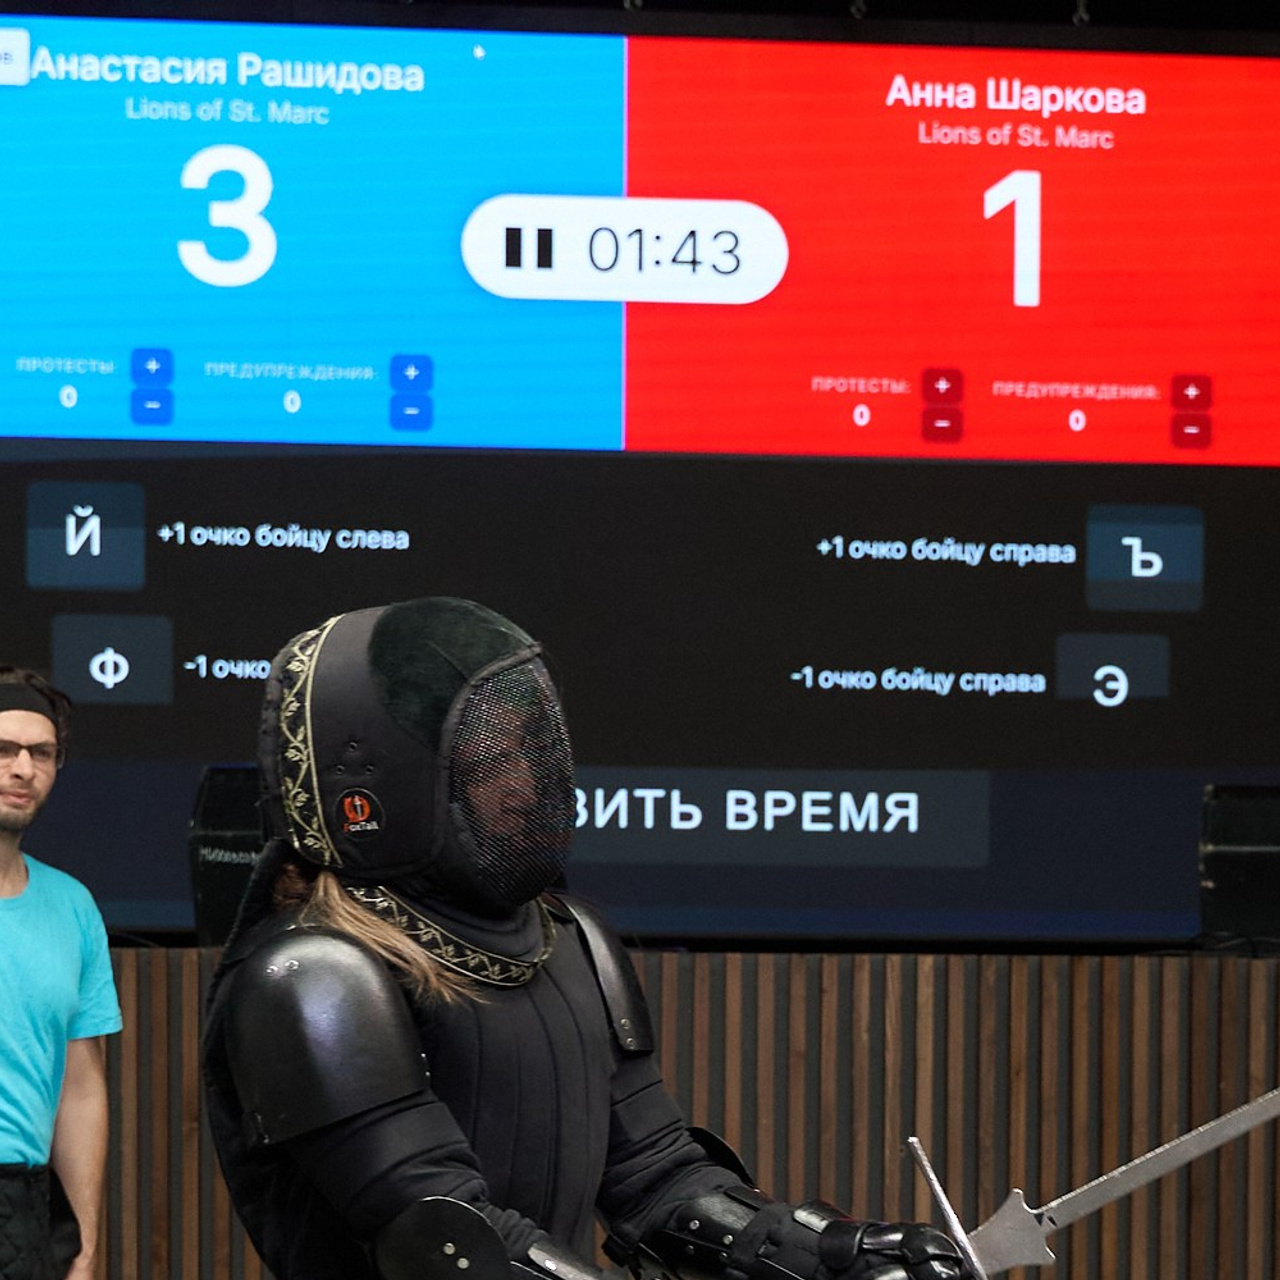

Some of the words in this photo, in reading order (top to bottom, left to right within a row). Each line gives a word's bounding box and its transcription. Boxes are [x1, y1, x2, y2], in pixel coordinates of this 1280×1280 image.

[31, 46, 227, 85] Анастасия
[238, 52, 425, 95] Рашидова
[126, 98, 192, 121] Lions
[197, 99, 223, 121] of
[230, 100, 261, 123] St.
[268, 102, 329, 125] Marc
[885, 74, 976, 109] Анна
[986, 78, 1146, 119] Шаркова
[918, 122, 982, 145] Lions
[986, 124, 1013, 146] of
[1017, 124, 1049, 147] St.
[1055, 126, 1114, 149] Marc
[178, 144, 277, 287] 3
[588, 226, 741, 275] 01:43
[984, 171, 1041, 307] 1
[59, 384, 78, 409] 0
[283, 389, 302, 414] 0
[852, 403, 871, 427] 0
[1068, 409, 1087, 432] 0
[65, 505, 101, 557] Й
[158, 521, 186, 545] +1
[190, 526, 251, 547] очко
[254, 523, 332, 554] бойцу
[335, 529, 410, 550] слева
[816, 535, 844, 558] +1
[848, 540, 907, 560] очко
[911, 537, 986, 566] бойцу
[989, 543, 1076, 566] справа
[1121, 536, 1164, 578] Ъ
[89, 647, 130, 689] Ф
[183, 654, 207, 678] -1
[212, 659, 271, 680] очко
[790, 665, 814, 689] -1
[818, 670, 877, 690] очко
[881, 667, 955, 696] бойцу
[959, 673, 1046, 696] справа
[1093, 665, 1129, 707] Э
[726, 789, 919, 833] ВРЕМЯ
